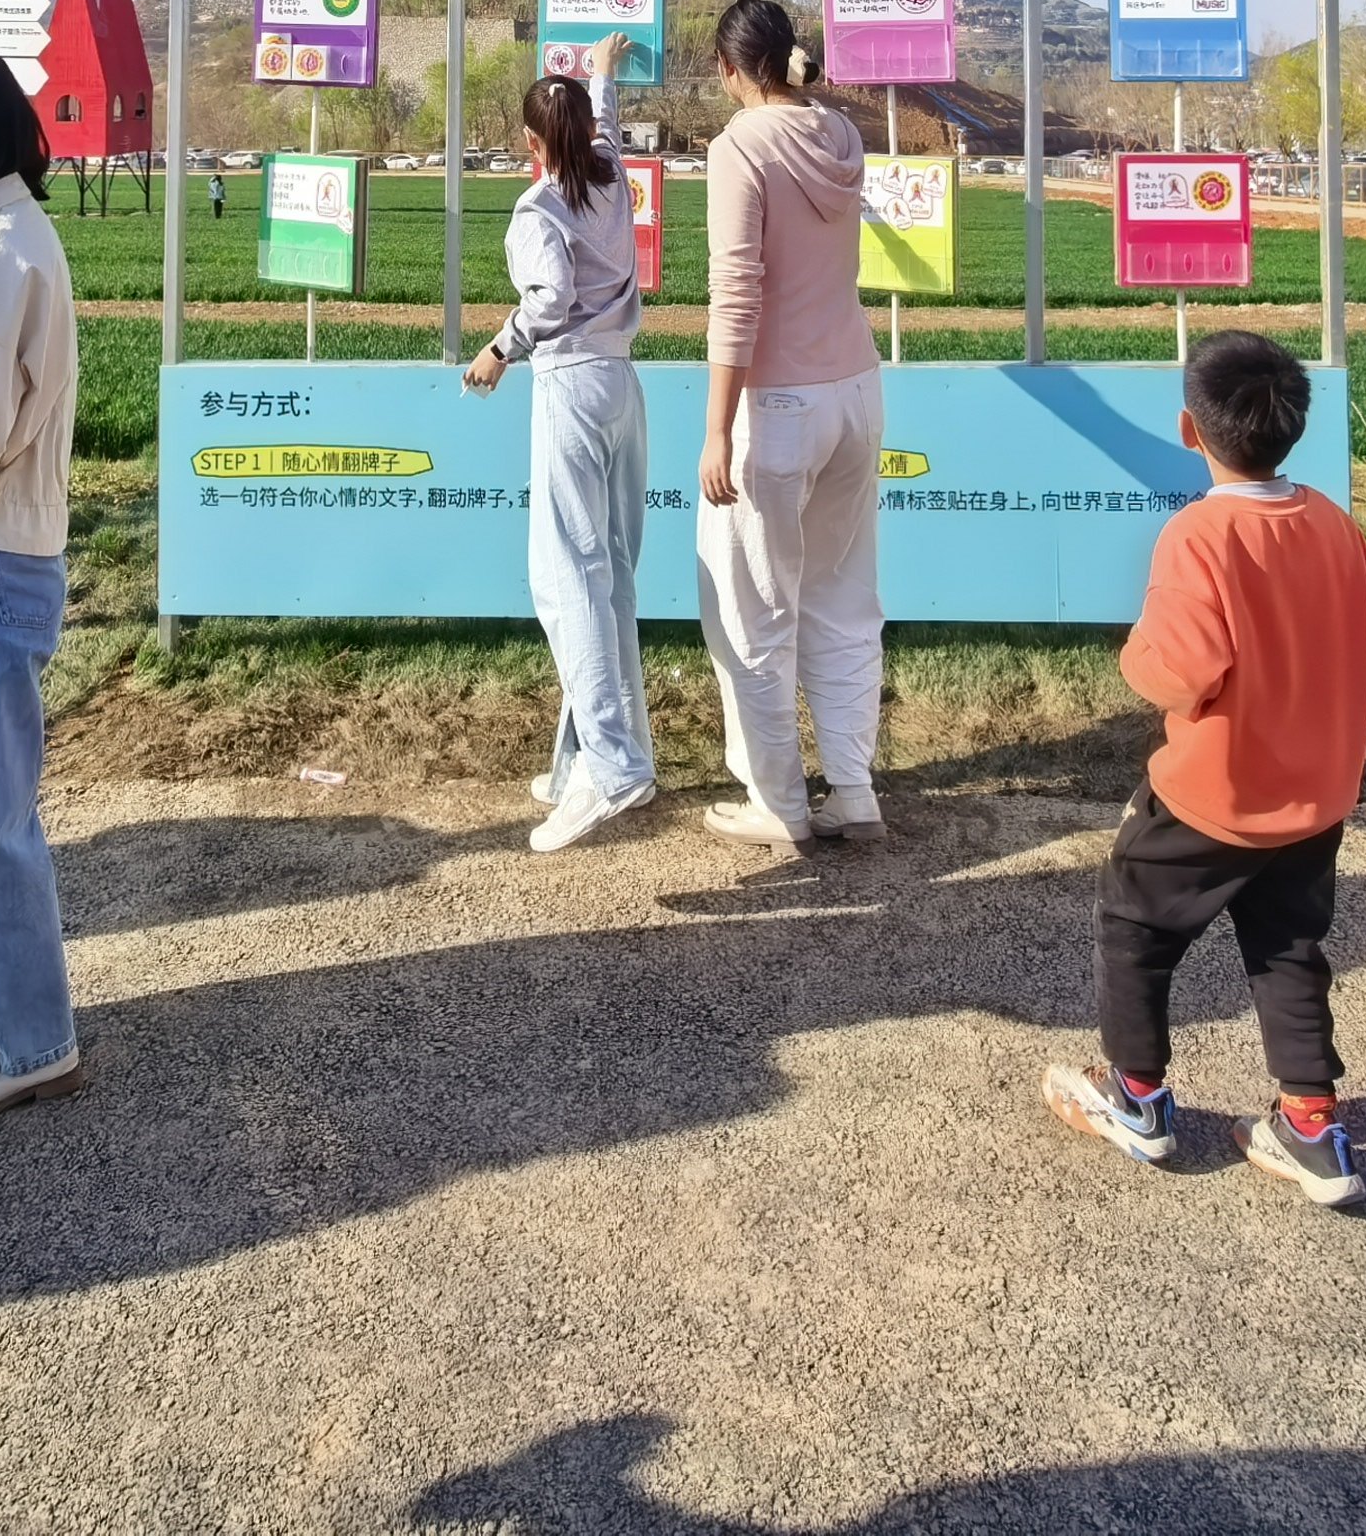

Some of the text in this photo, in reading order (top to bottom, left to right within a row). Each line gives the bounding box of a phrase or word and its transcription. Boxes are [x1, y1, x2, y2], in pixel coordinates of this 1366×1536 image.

[1196, 0, 1226, 10] MUSIC
[200, 391, 312, 418] 参与方式：
[200, 451, 401, 473] STEP 1 随心情翻牌子
